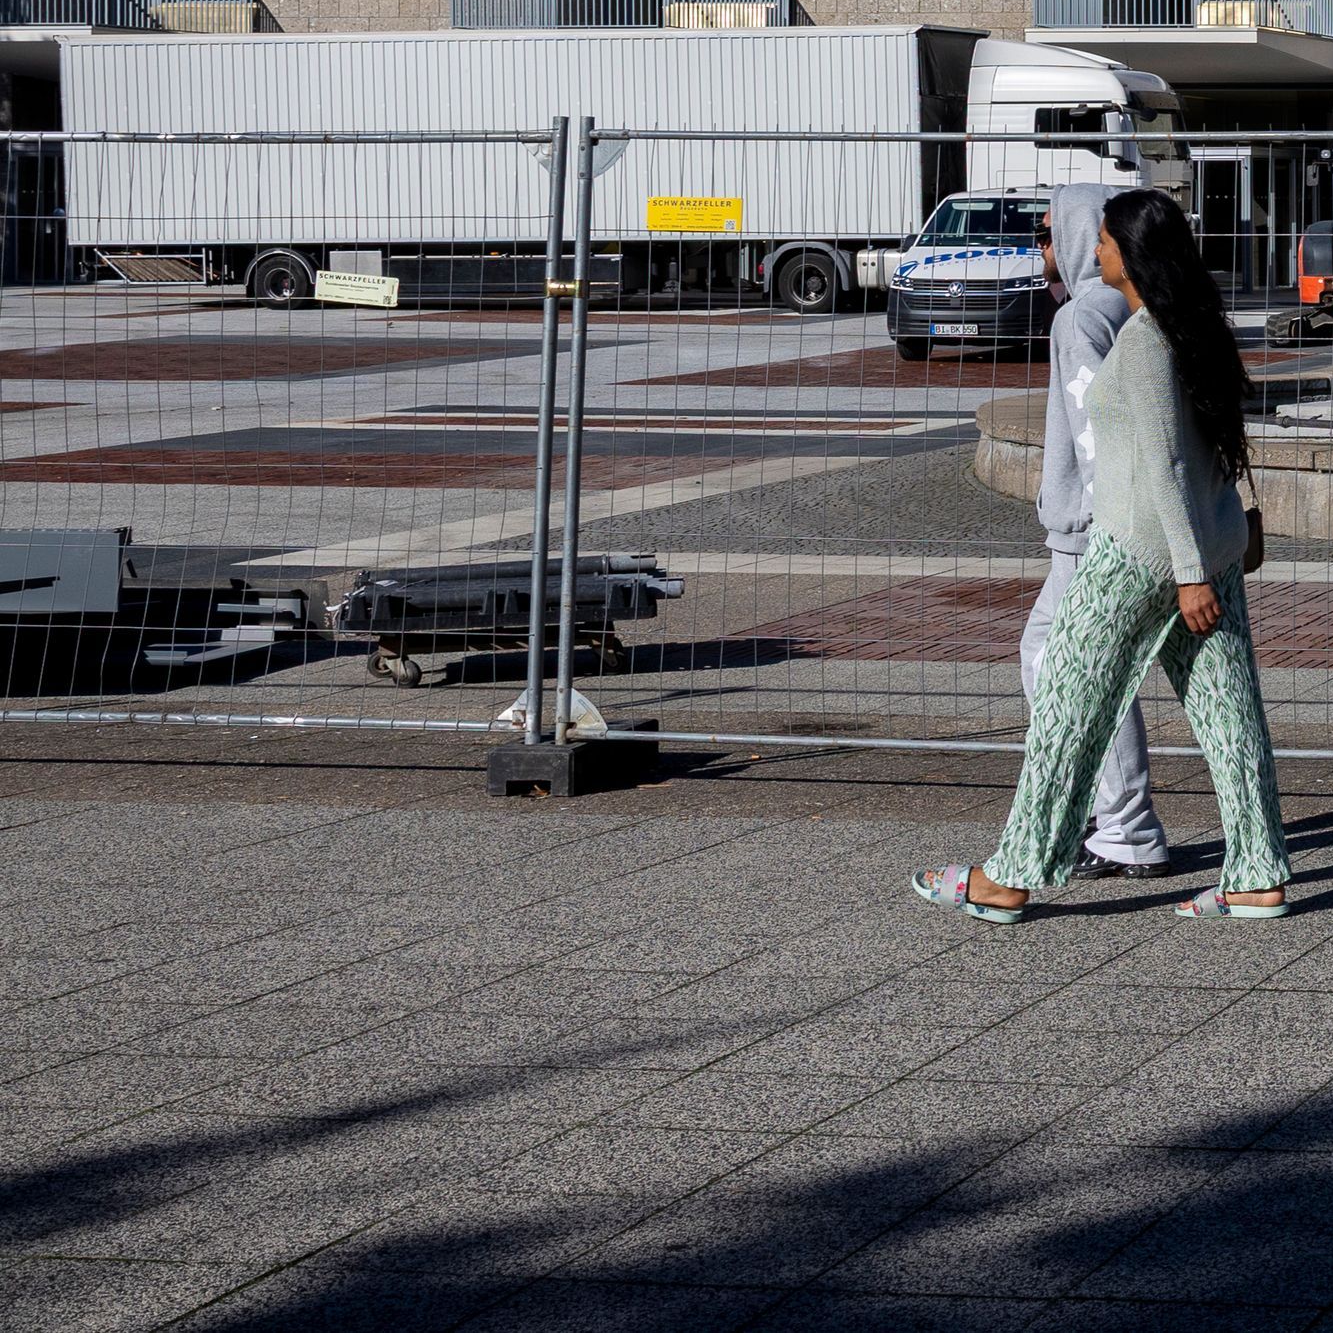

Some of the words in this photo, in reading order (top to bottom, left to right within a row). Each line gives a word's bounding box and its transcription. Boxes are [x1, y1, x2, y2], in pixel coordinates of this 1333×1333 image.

[652, 199, 732, 208] SCHWARZFELLER
[924, 247, 1043, 265] BOGE
[319, 273, 387, 285] SCHWARZFELLER
[935, 324, 945, 334] BI
[950, 324, 961, 334] BK
